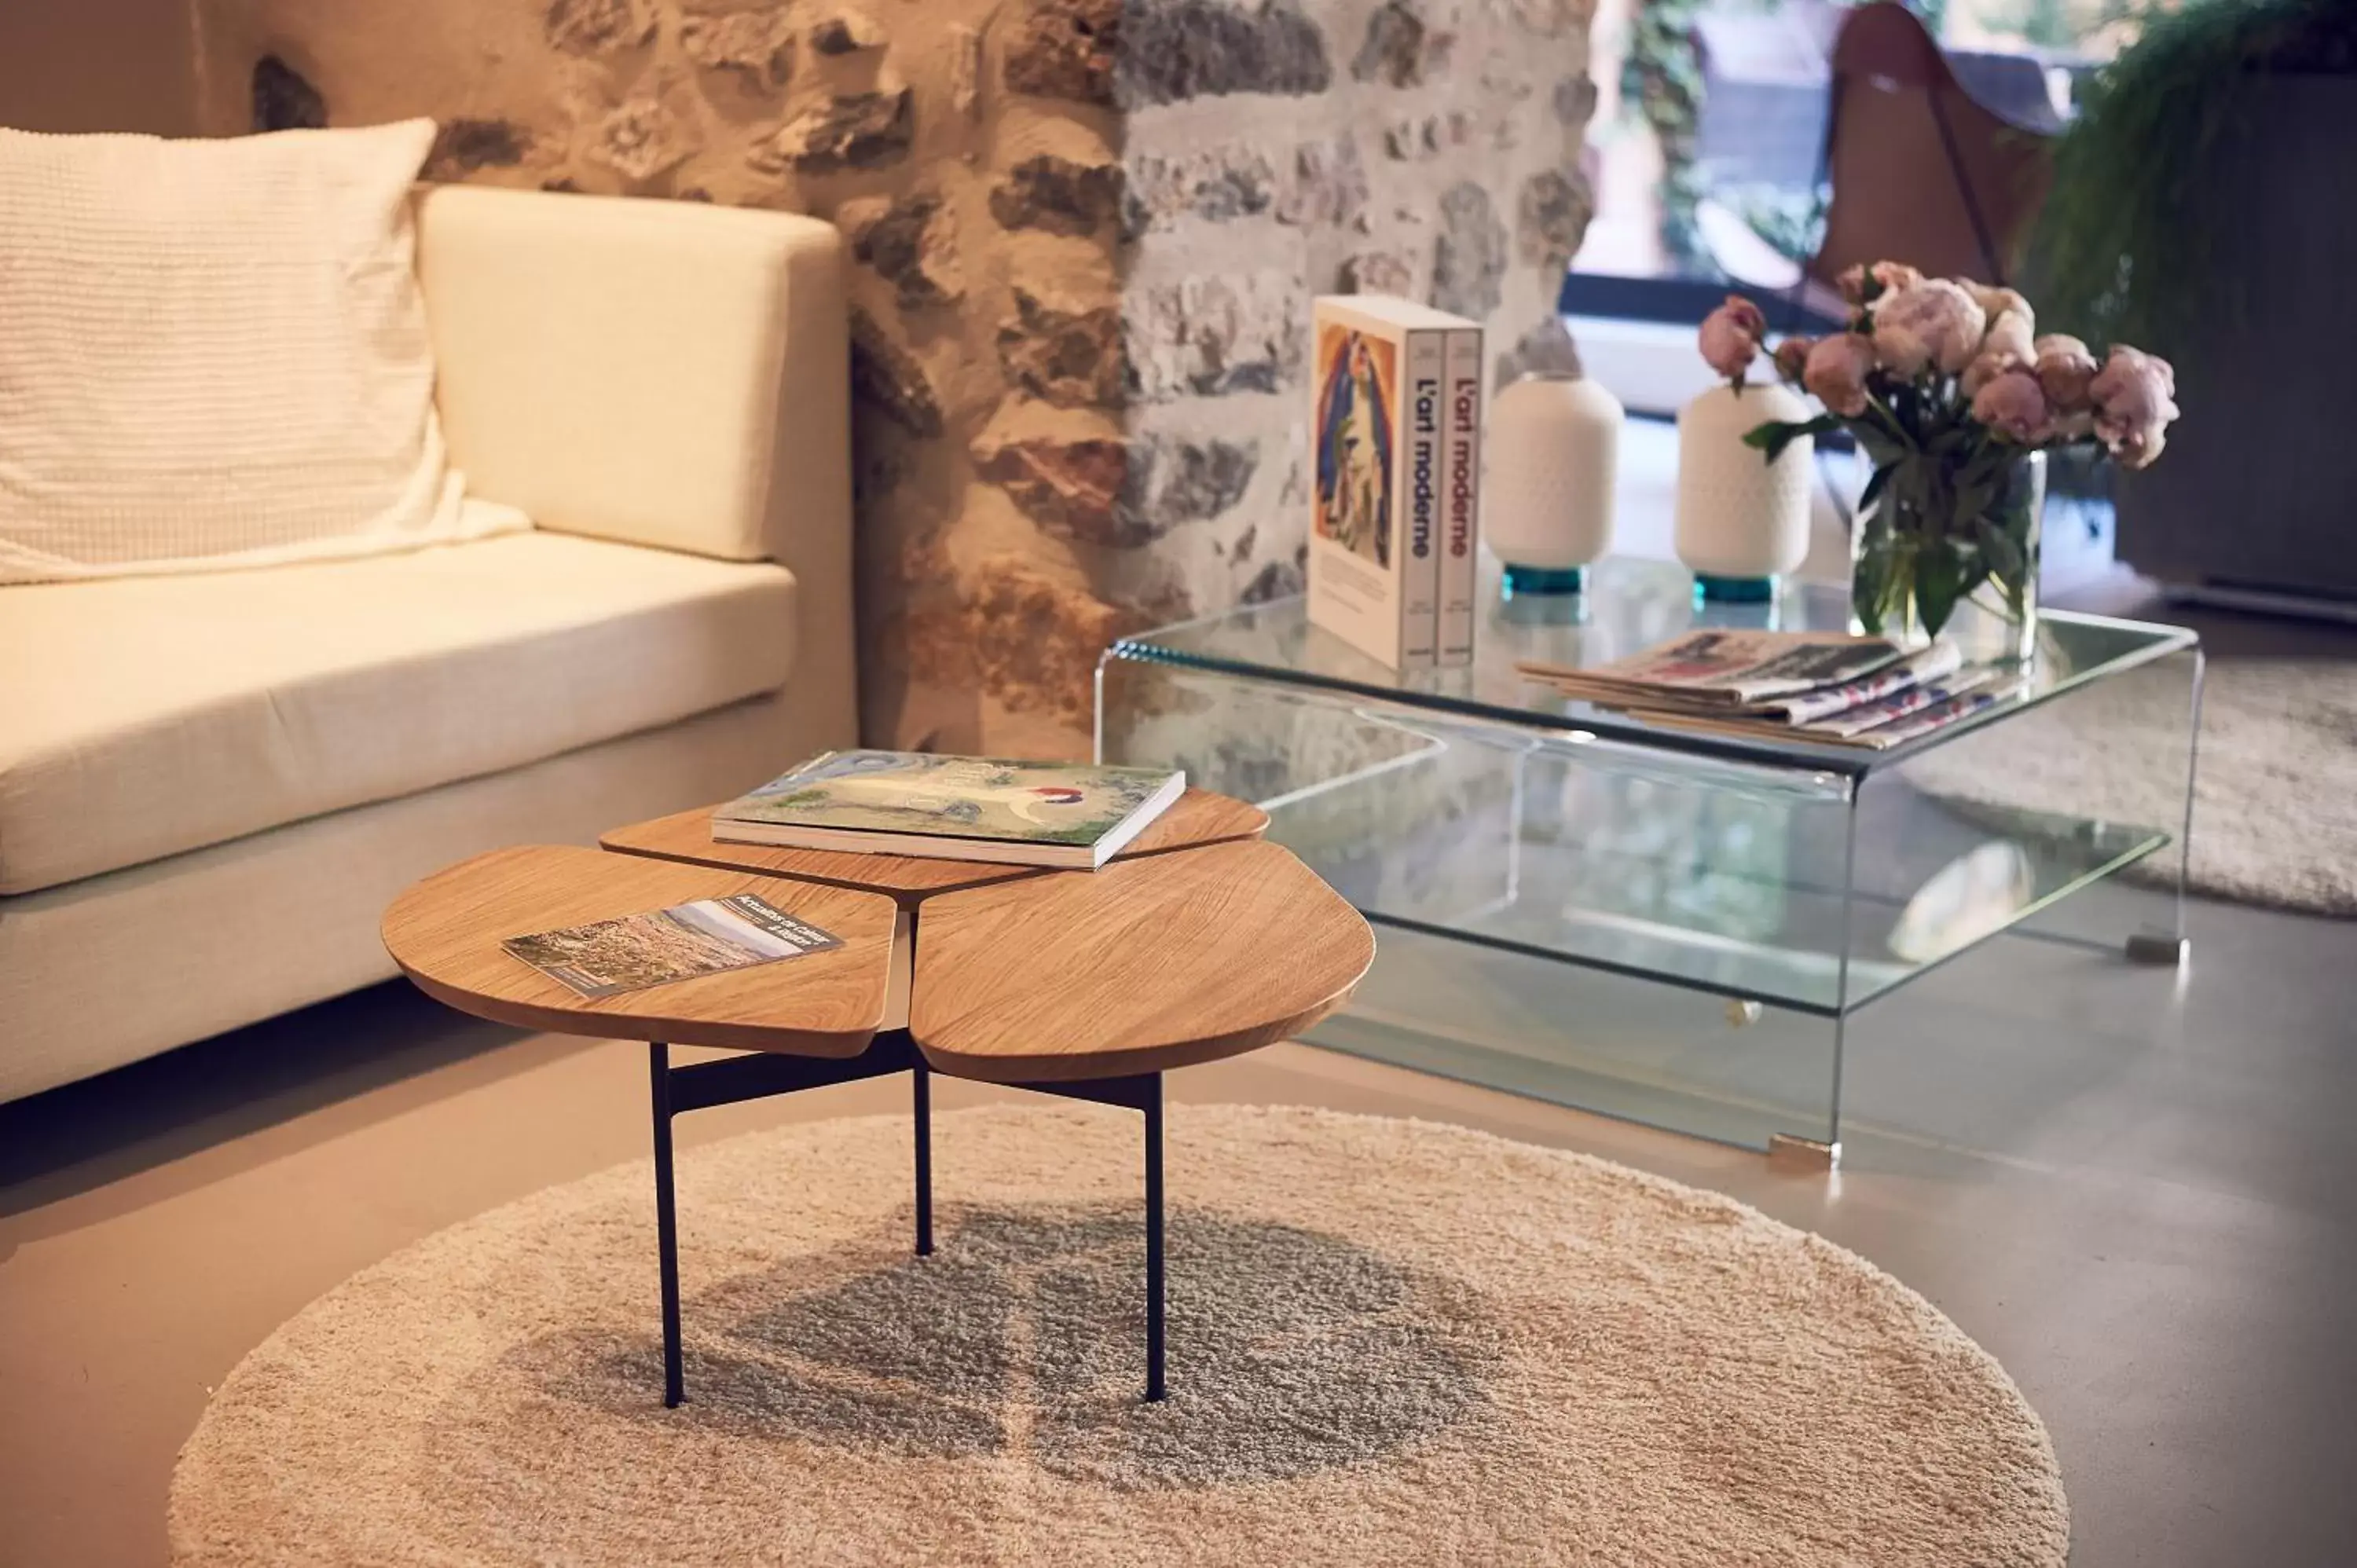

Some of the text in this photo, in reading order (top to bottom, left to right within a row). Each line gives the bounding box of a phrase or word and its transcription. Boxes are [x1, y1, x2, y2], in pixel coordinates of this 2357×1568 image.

[1416, 379, 1437, 432] L'art
[1455, 378, 1477, 431] L'art
[1412, 441, 1435, 558] moderne
[1450, 441, 1475, 558] moderne
